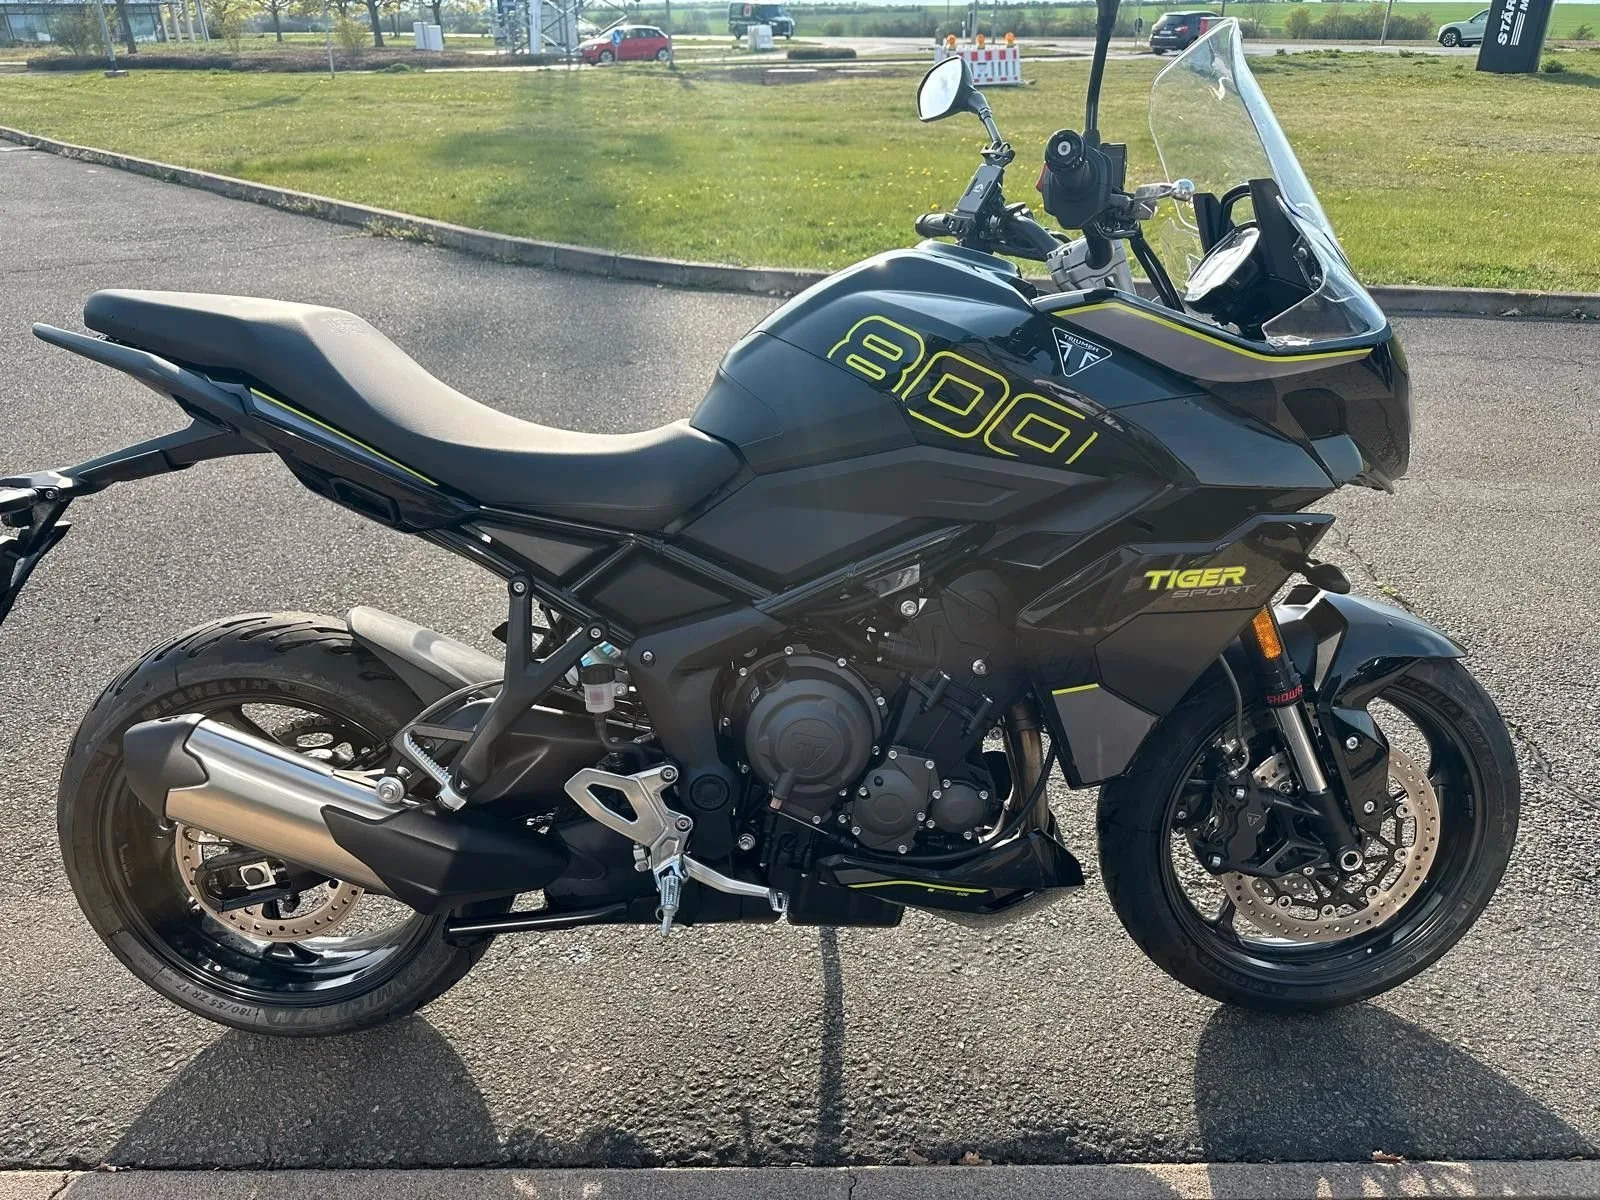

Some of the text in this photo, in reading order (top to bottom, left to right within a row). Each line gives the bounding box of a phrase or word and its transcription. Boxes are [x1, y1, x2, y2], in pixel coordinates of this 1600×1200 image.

[1063, 334, 1099, 353] TRIUMPH
[827, 315, 1098, 464] 800
[1144, 565, 1246, 590] TIGER
[1172, 585, 1256, 598] SPORT
[176, 983, 253, 1017] 180/55 ZR 17
